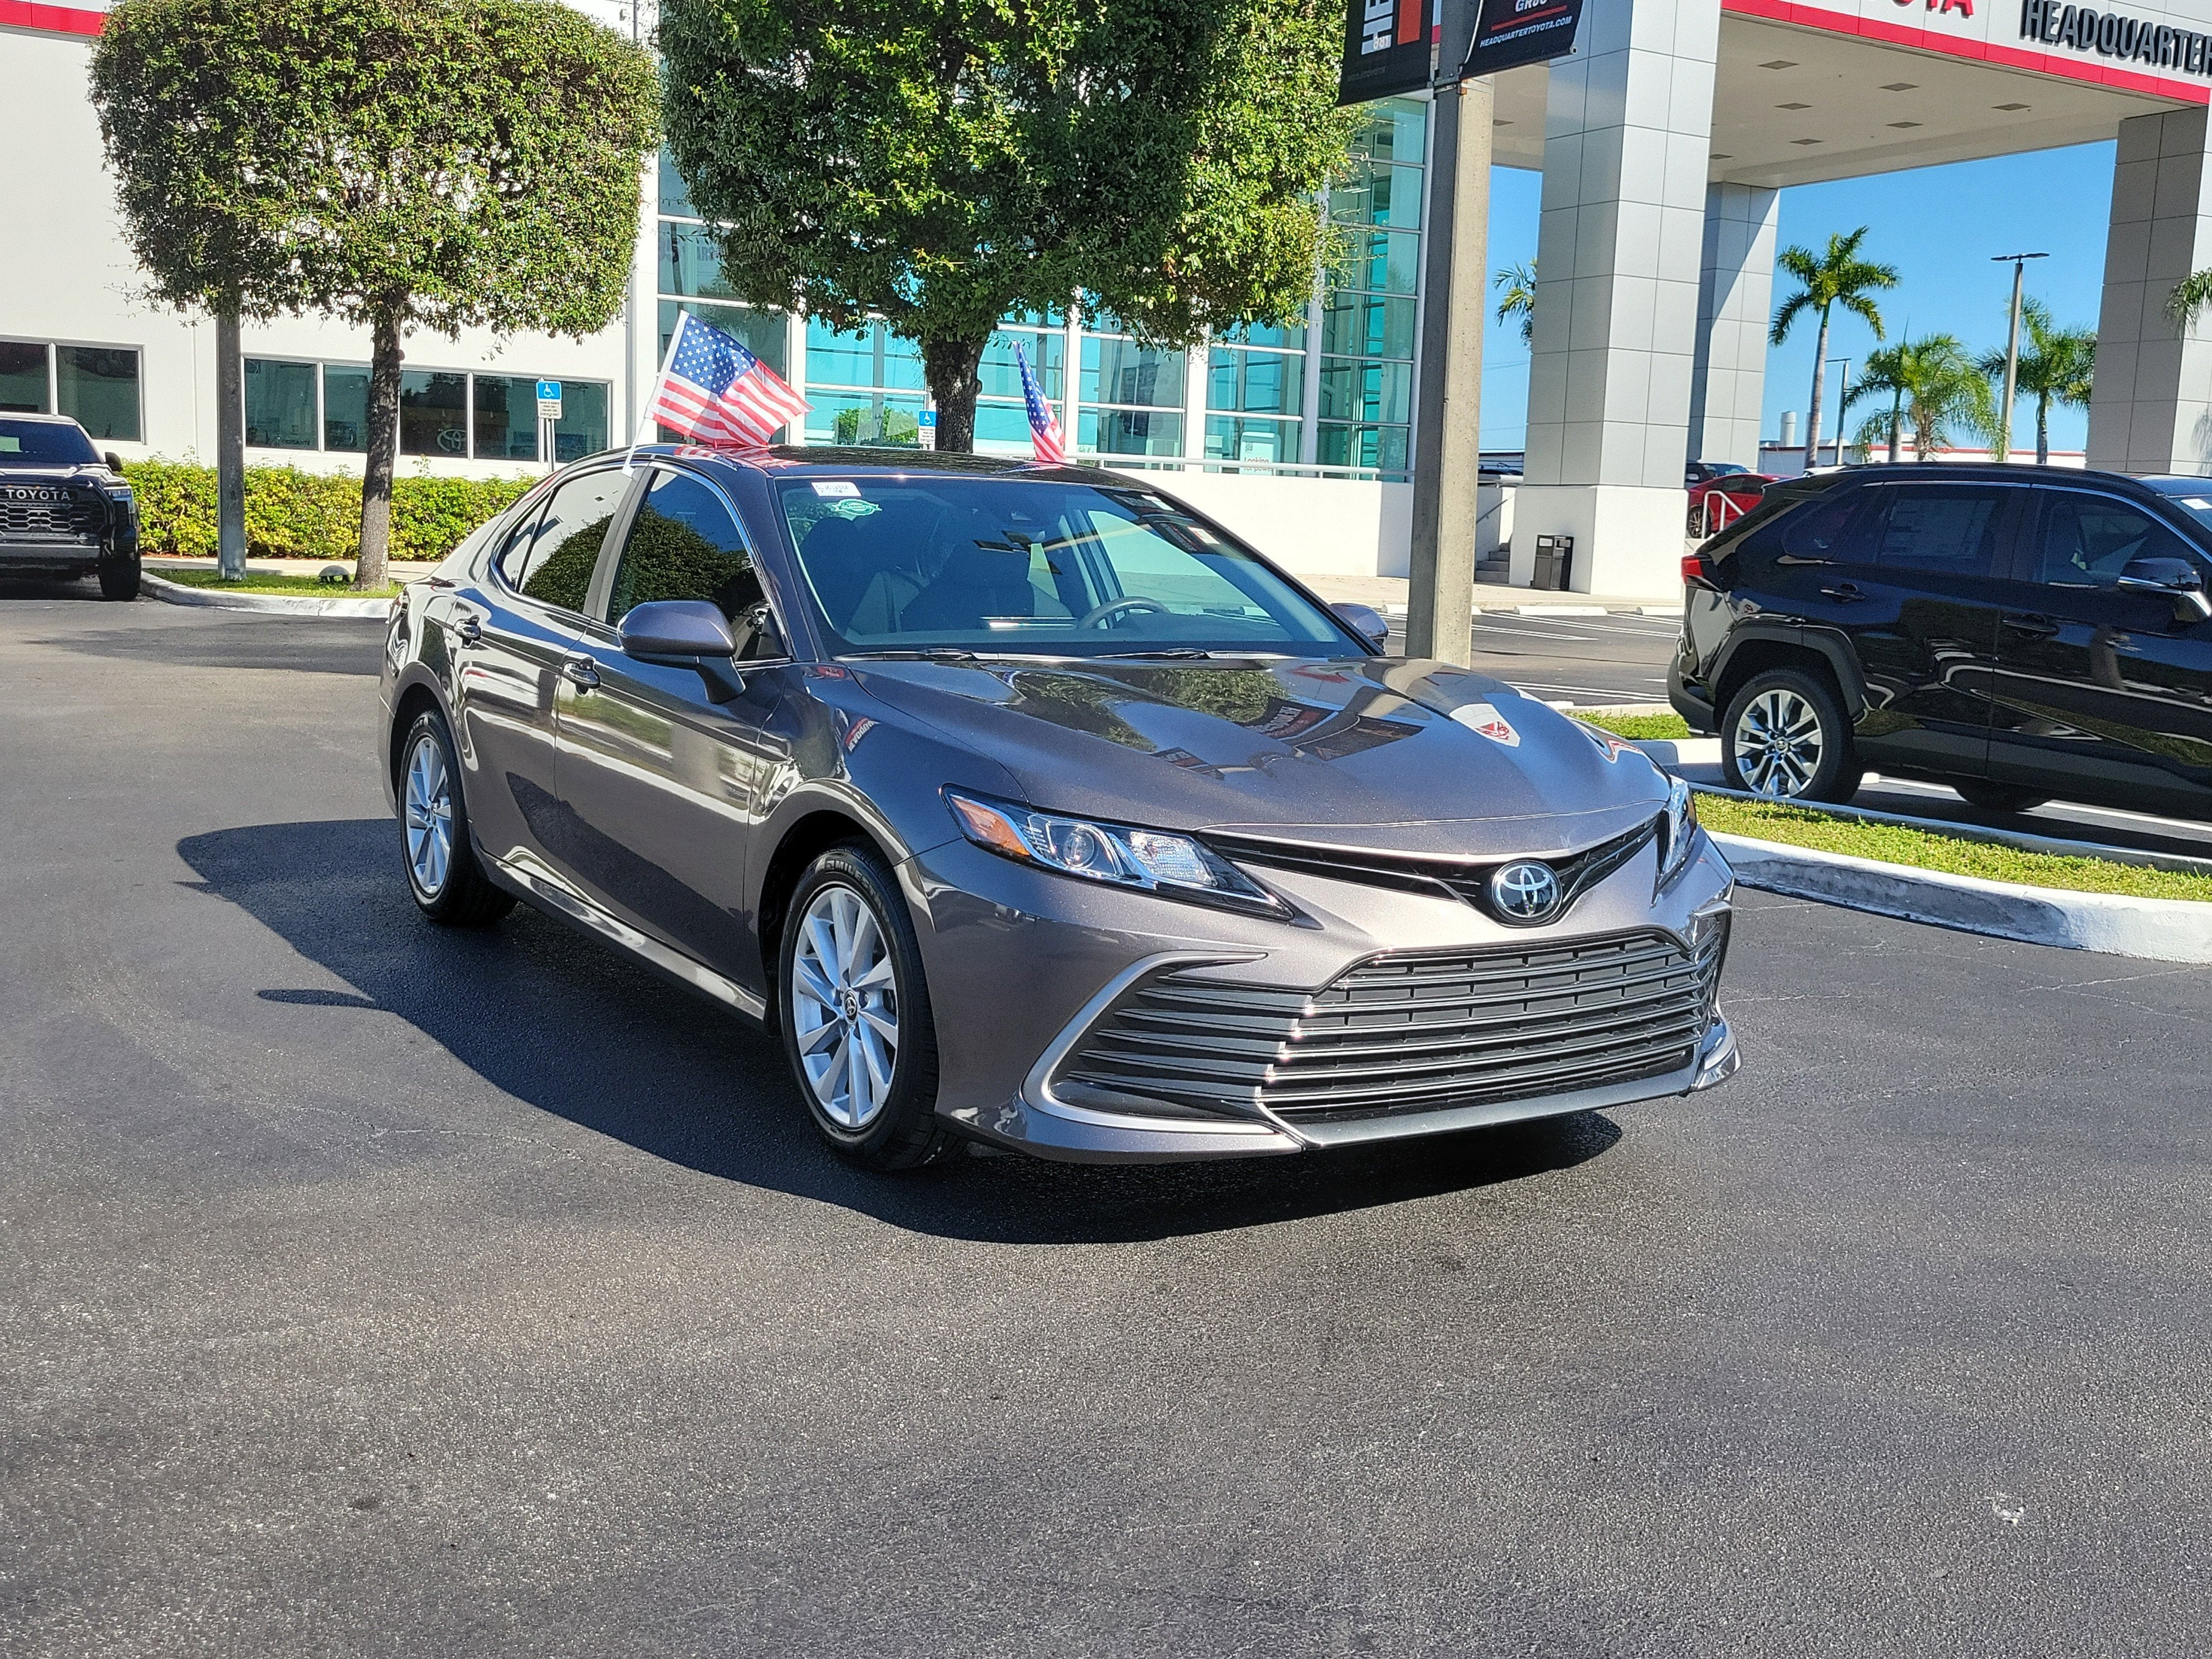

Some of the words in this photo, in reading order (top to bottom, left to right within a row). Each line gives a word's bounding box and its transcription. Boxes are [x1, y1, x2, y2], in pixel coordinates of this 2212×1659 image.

[1480, 15, 1572, 48] HEADQUARTERTOYOTA.COM
[5, 489, 70, 501] TOYOTA
[836, 860, 890, 923] MILESTAR
